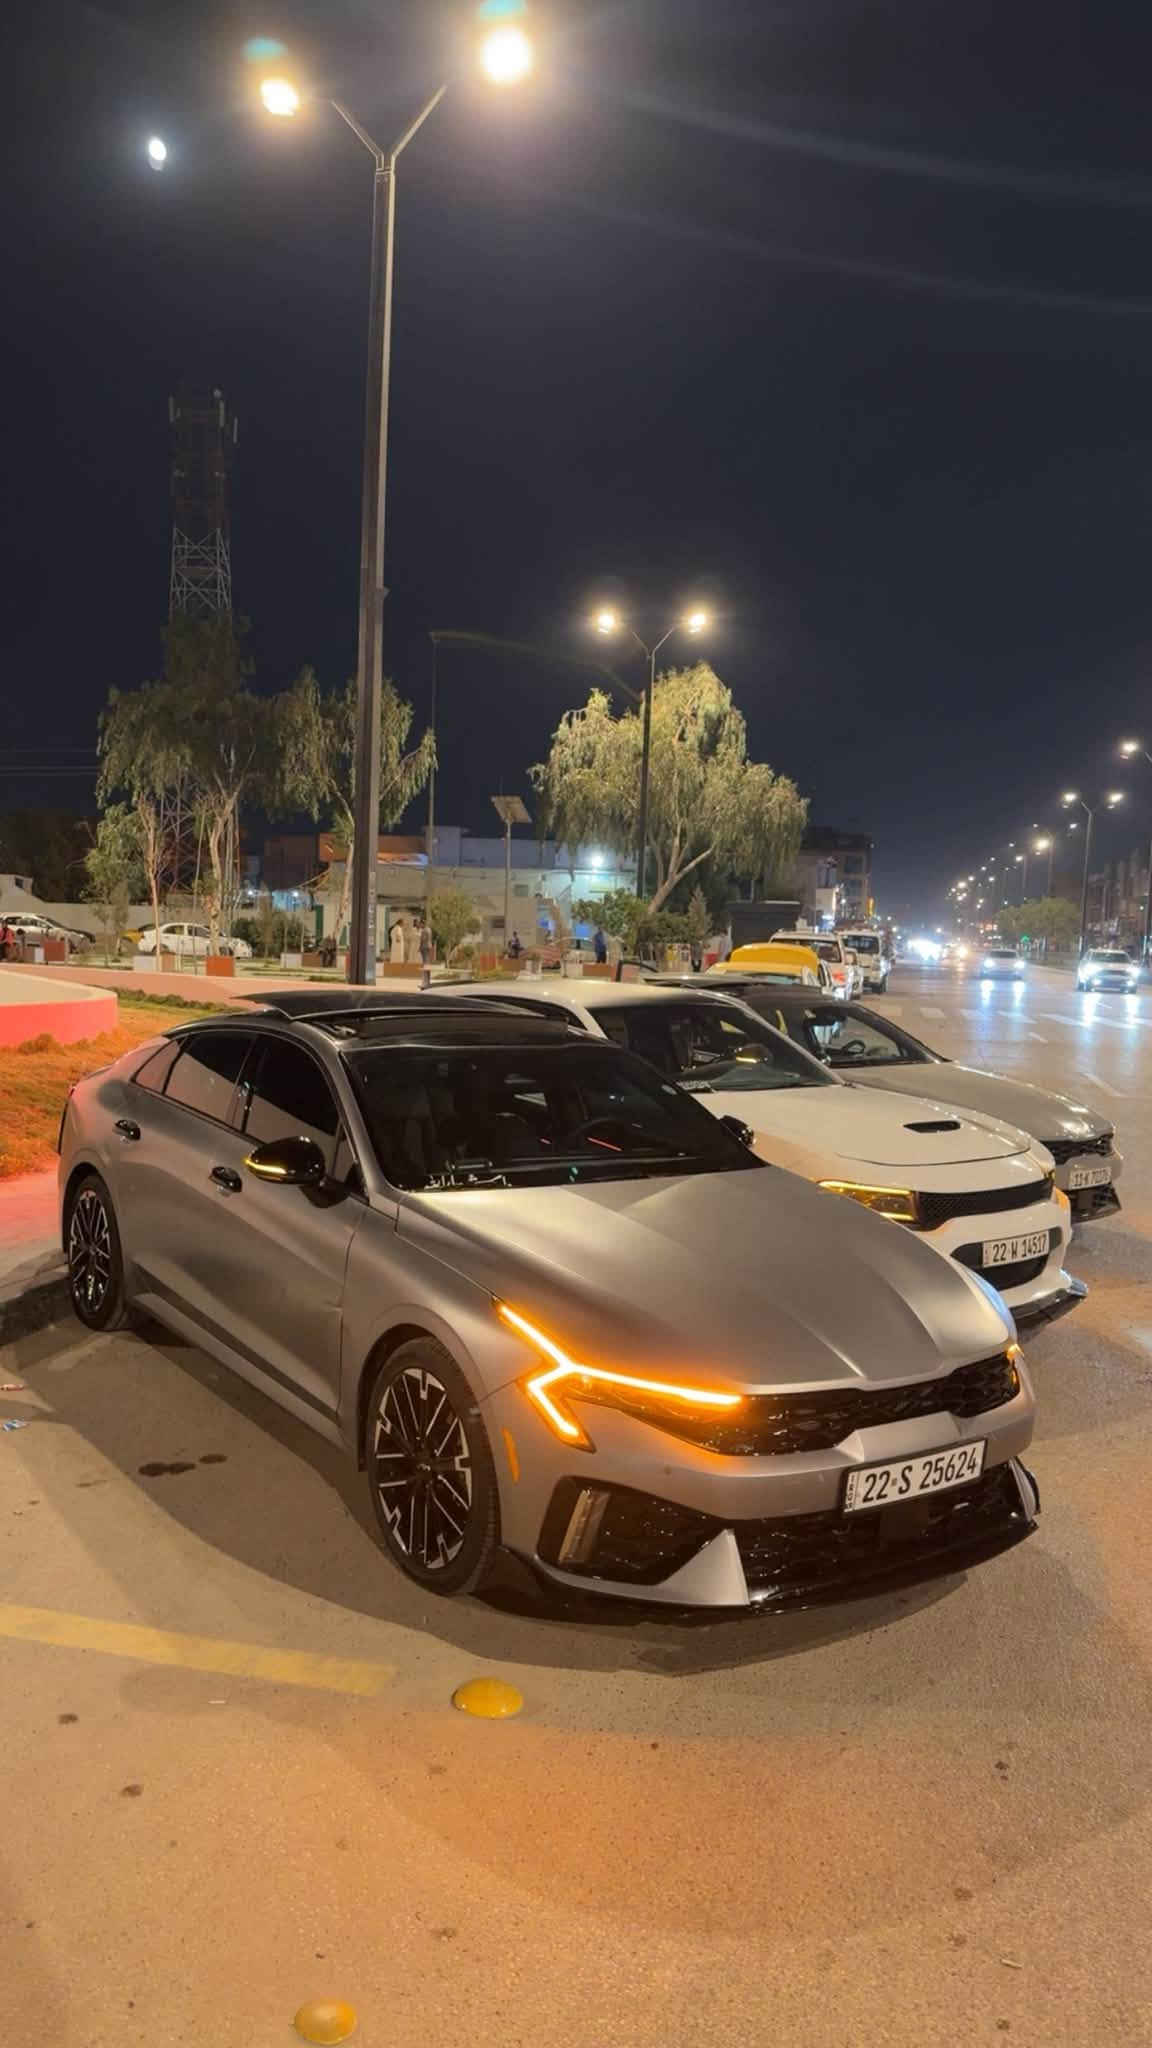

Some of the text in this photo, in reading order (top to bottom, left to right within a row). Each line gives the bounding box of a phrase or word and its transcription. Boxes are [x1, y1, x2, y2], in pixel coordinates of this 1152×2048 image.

[992, 1242, 1007, 1263] 22
[862, 1471, 890, 1503] 22
[898, 1465, 912, 1495] S
[919, 1448, 976, 1489] 25624
